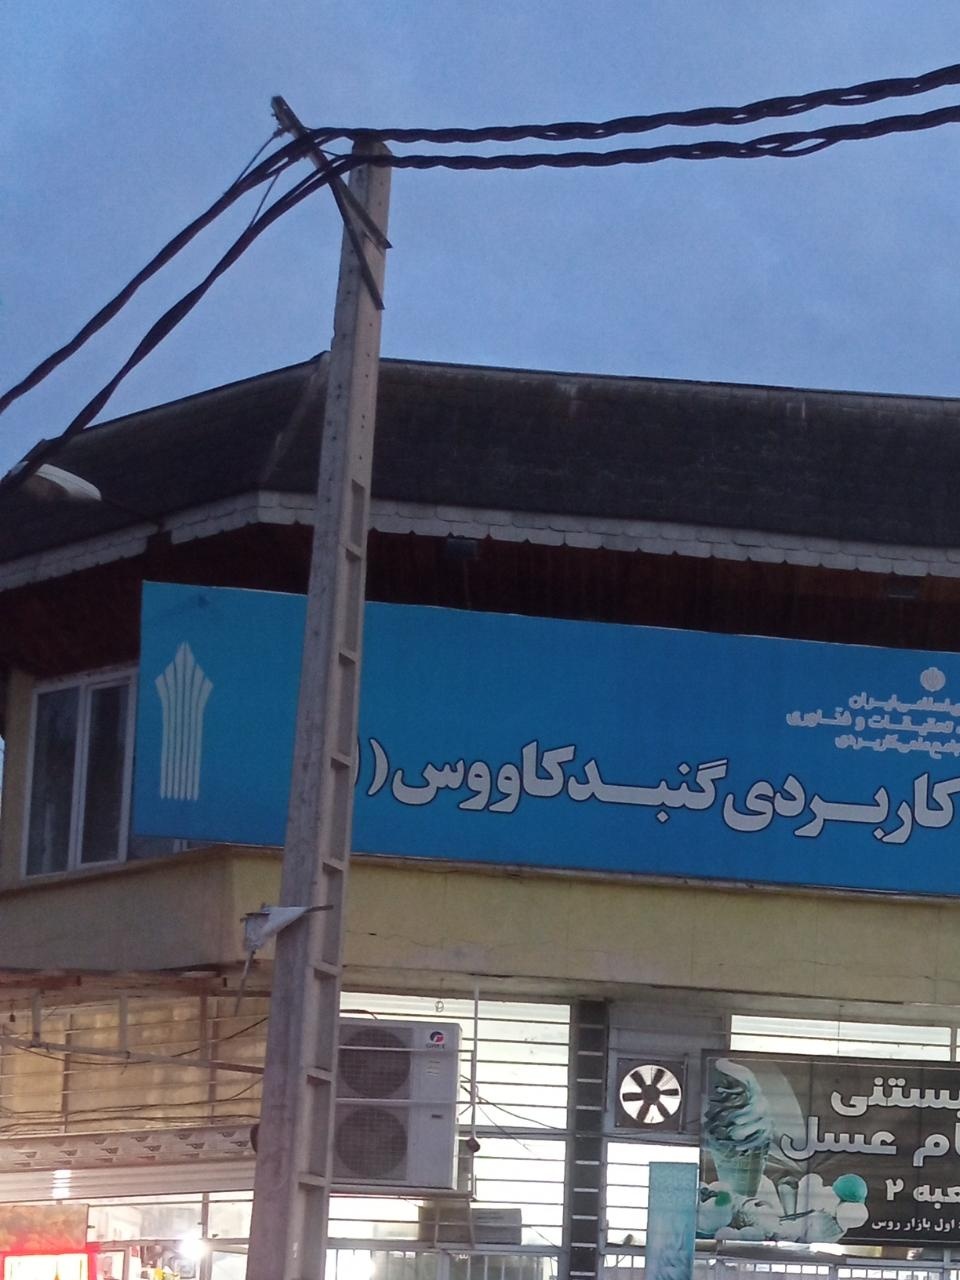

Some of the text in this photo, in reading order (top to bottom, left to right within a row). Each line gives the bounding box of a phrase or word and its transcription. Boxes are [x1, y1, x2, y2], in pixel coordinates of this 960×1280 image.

[848, 692, 898, 712] ایران
[786, 707, 852, 727] فناوری
[854, 716, 866, 731] و
[868, 714, 954, 736] تحقیقات
[780, 1116, 897, 1161] عسل
[885, 1179, 905, 1201] ۲
[871, 1220, 900, 1231] روس
[904, 1218, 931, 1232] بازار
[934, 1219, 955, 1232] اول
